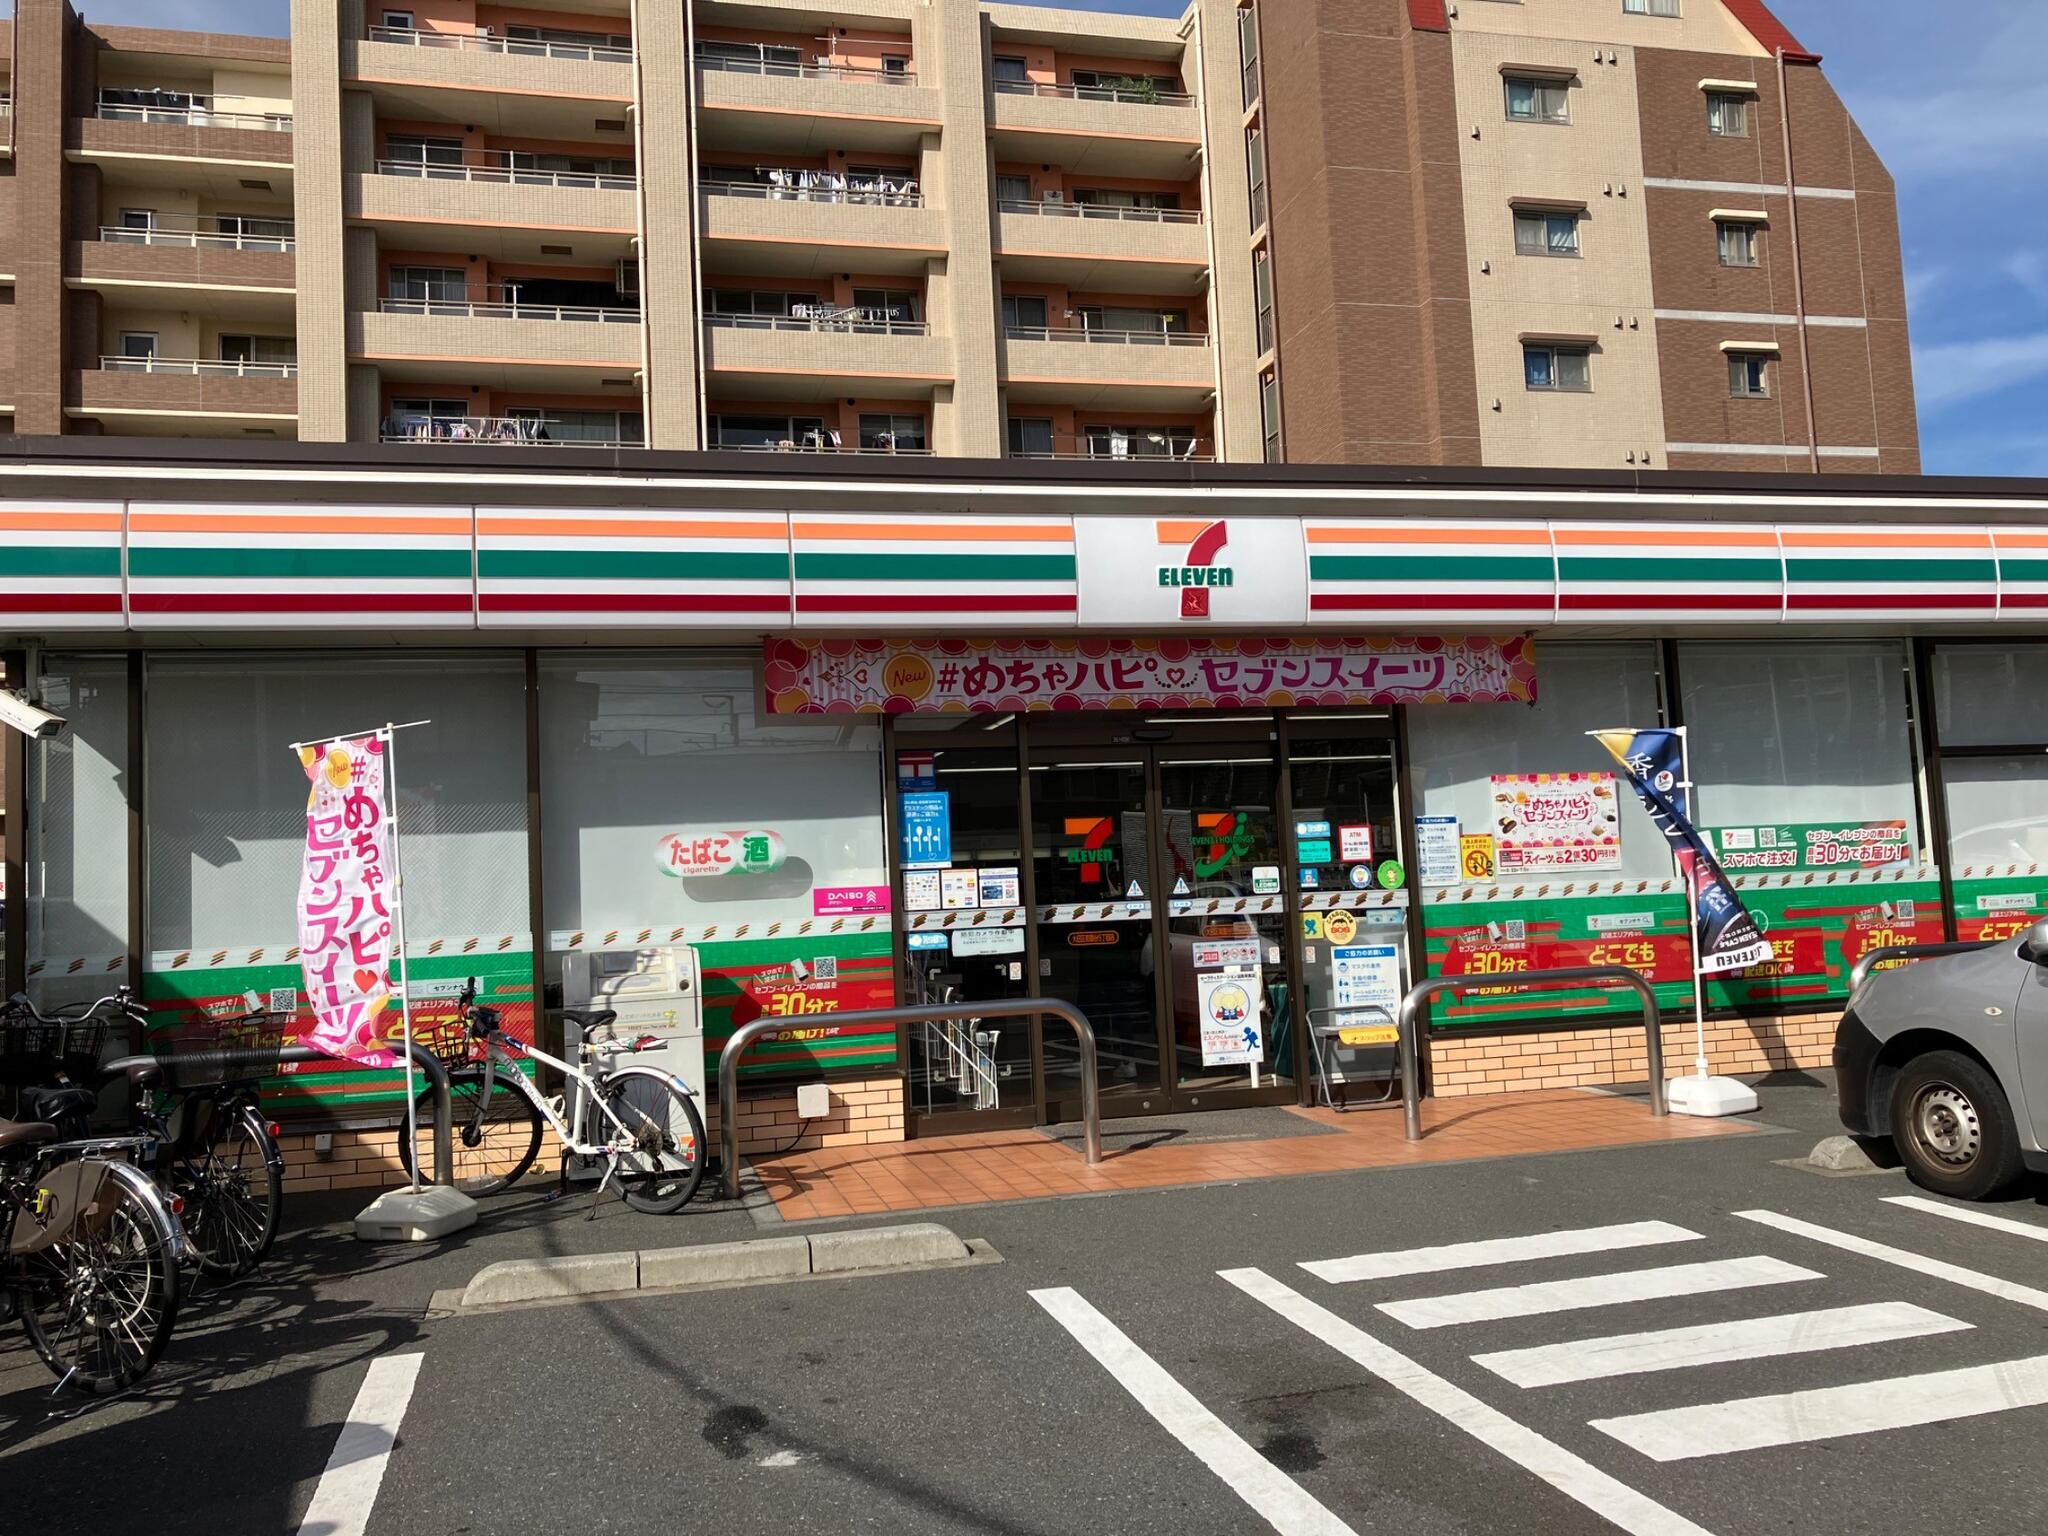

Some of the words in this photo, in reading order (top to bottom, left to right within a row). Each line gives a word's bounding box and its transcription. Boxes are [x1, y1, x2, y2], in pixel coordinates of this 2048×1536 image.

[893, 670, 927, 687] New
[1198, 655, 1446, 693] セブンスイーツ
[1523, 807, 1589, 823] セブンスイーツ
[670, 837, 732, 866] たばこ
[742, 836, 769, 863] 酒
[683, 864, 720, 874] cigarette
[827, 891, 864, 902] DAISO
[303, 814, 365, 1046] セブンスイーツ
[1588, 942, 1655, 966] どこでも
